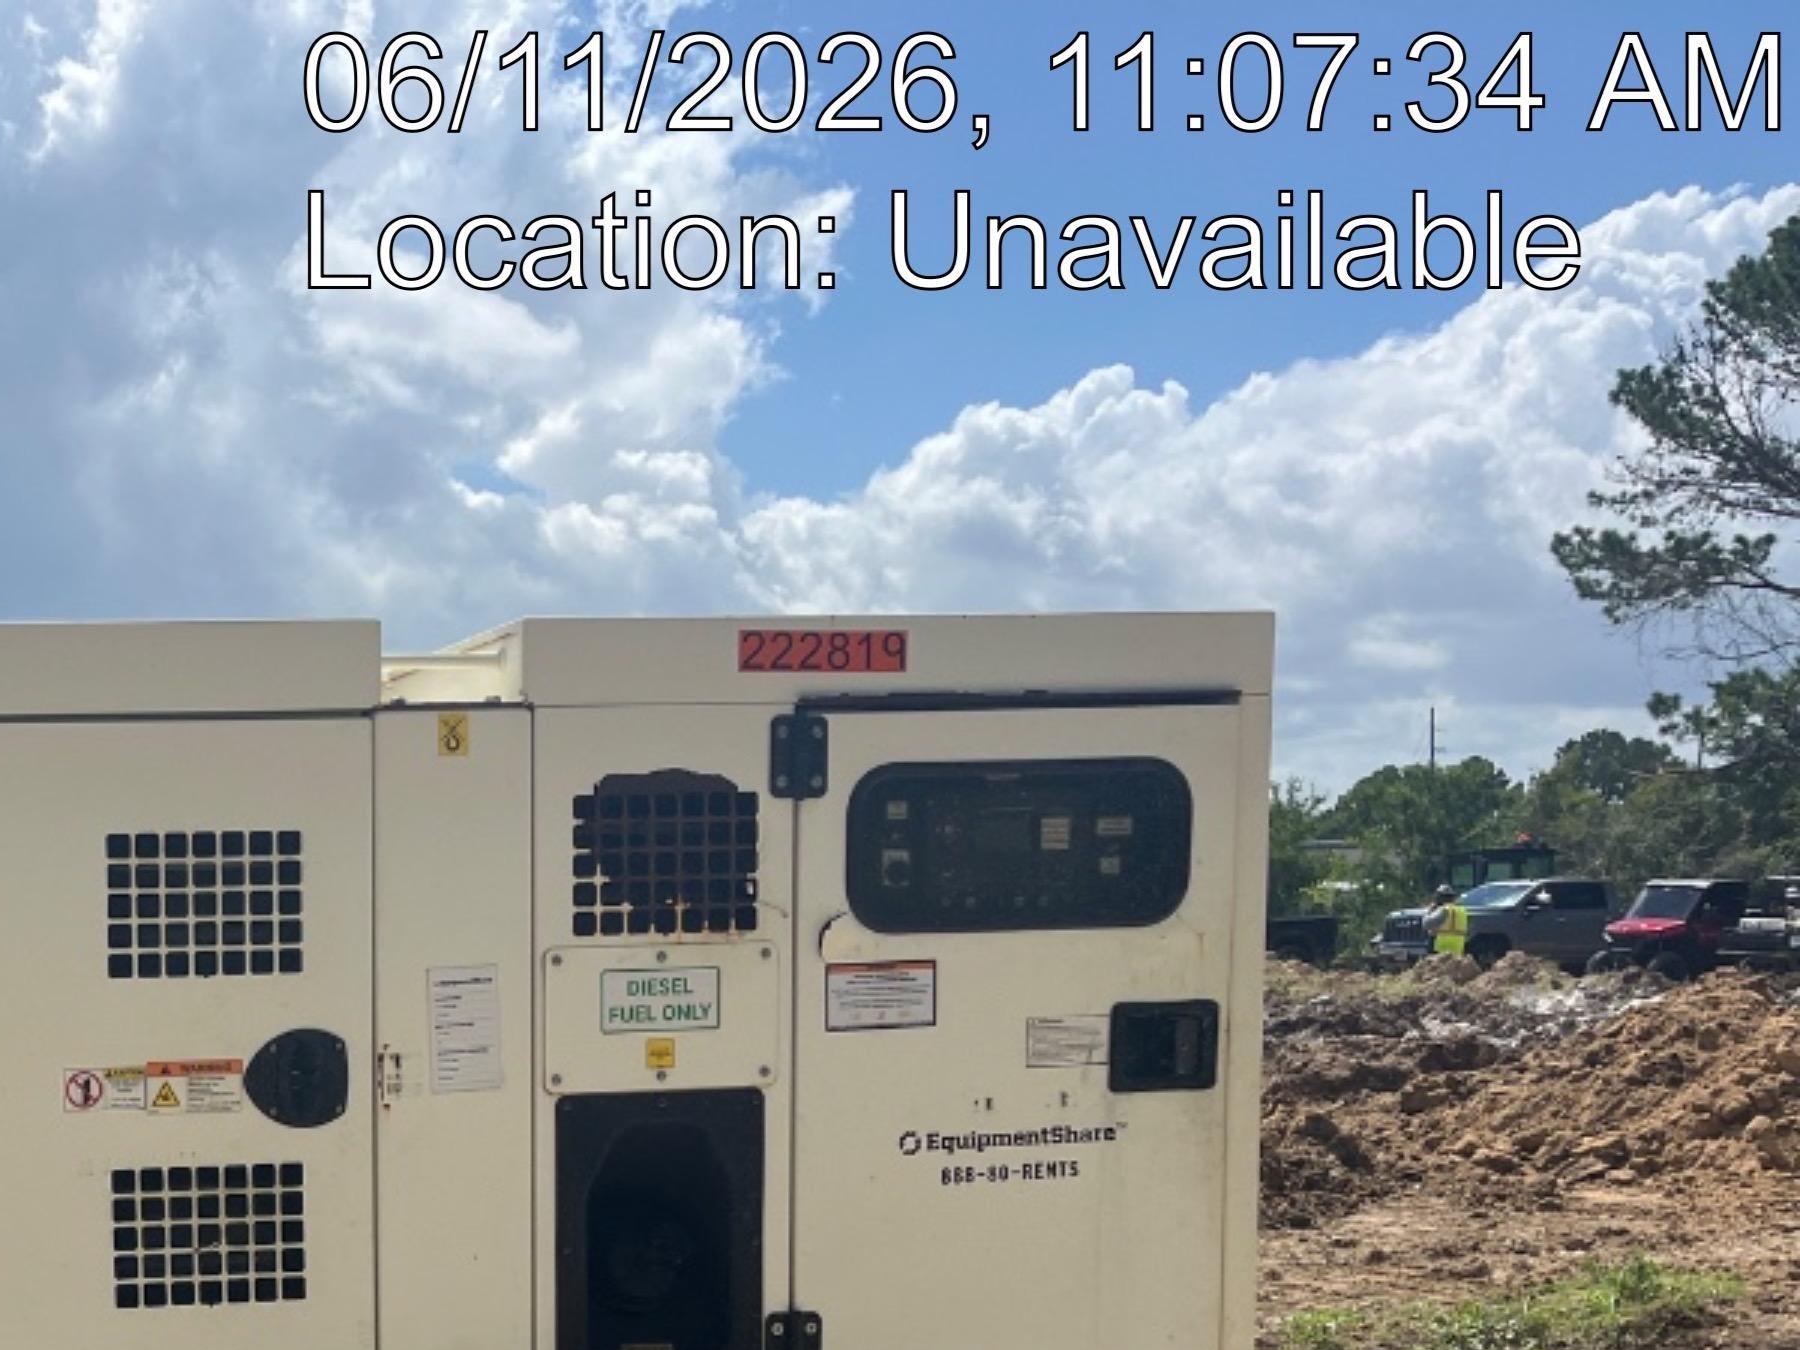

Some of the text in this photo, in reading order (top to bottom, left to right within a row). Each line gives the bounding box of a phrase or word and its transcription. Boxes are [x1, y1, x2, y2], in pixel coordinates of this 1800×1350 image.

[742, 632, 907, 670] 222819
[626, 977, 694, 997] DIESEL
[608, 1002, 712, 1024] FUEL ONLY
